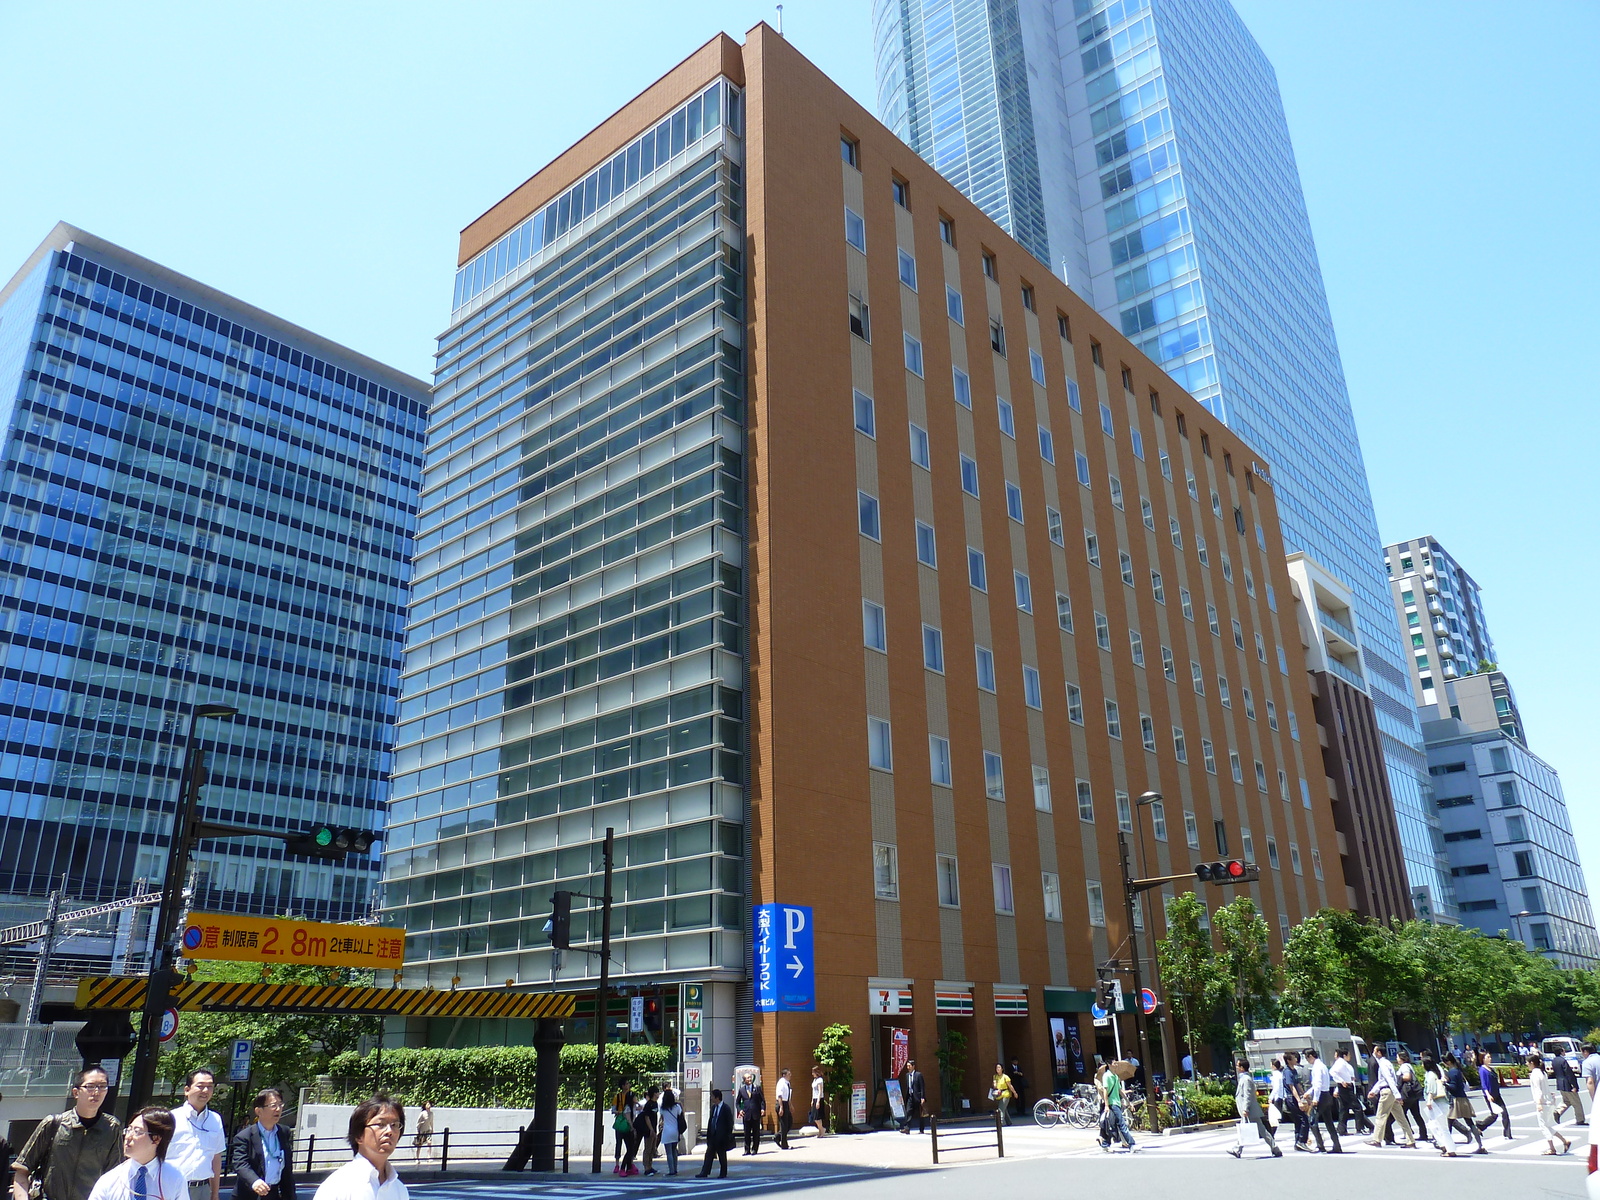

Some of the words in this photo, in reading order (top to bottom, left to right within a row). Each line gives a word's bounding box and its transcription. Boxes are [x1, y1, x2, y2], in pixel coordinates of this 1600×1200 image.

[1417, 893, 1431, 925] 千代
[783, 908, 805, 950] P
[200, 925, 221, 949] 意
[221, 929, 260, 949] 制限高
[260, 926, 327, 958] 2.8m
[329, 937, 374, 955] 2t車以上
[376, 938, 402, 960] 注意
[235, 1042, 249, 1059] P
[687, 1039, 696, 1054] P
[686, 1068, 700, 1081] FJB
